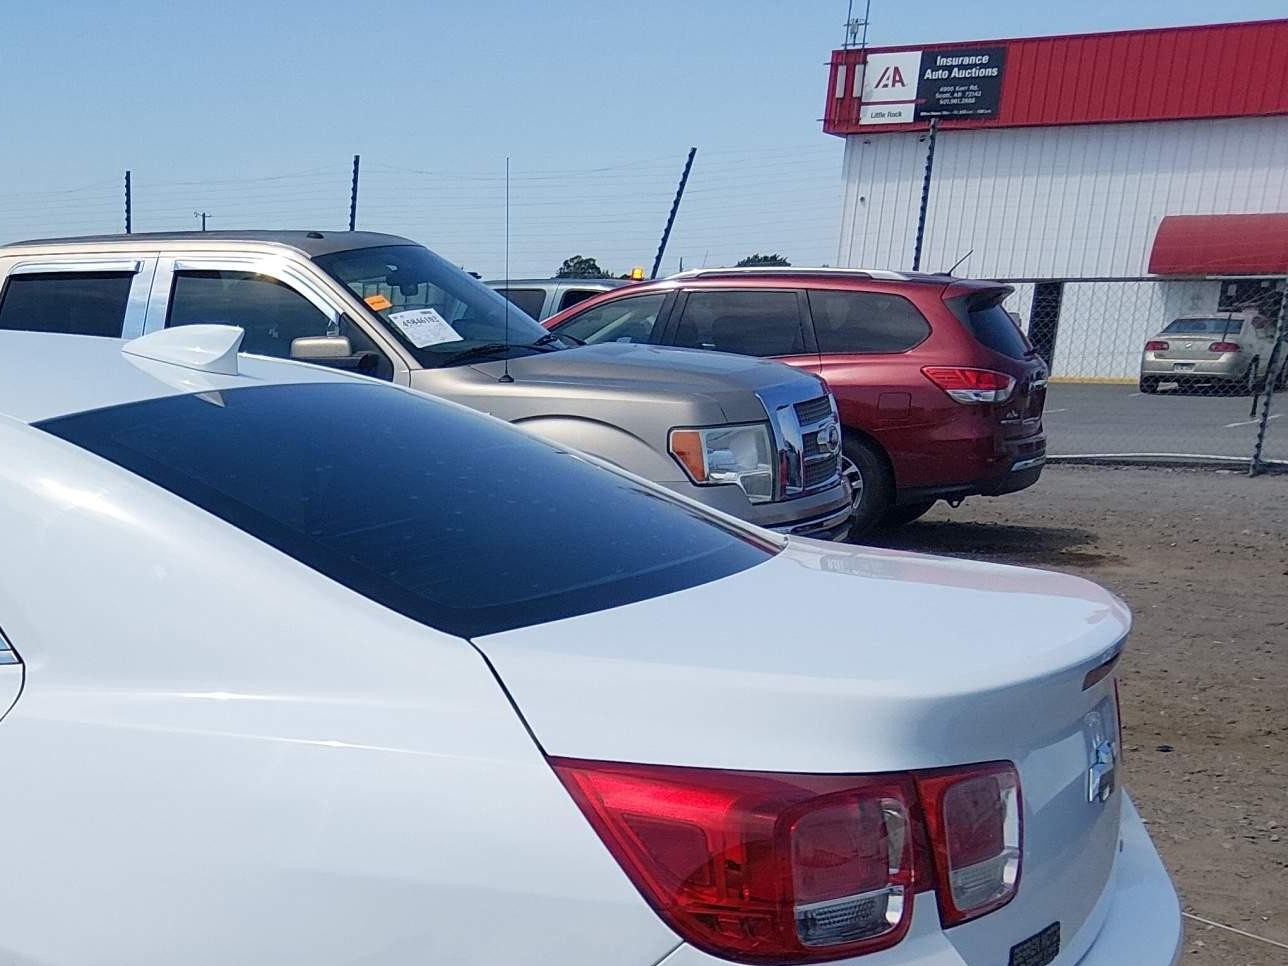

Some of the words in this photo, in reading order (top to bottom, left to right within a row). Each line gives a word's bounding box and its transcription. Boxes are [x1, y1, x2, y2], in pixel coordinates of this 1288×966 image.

[936, 55, 989, 66] Insurance
[924, 68, 949, 80] Auto
[951, 67, 998, 78] Auctions
